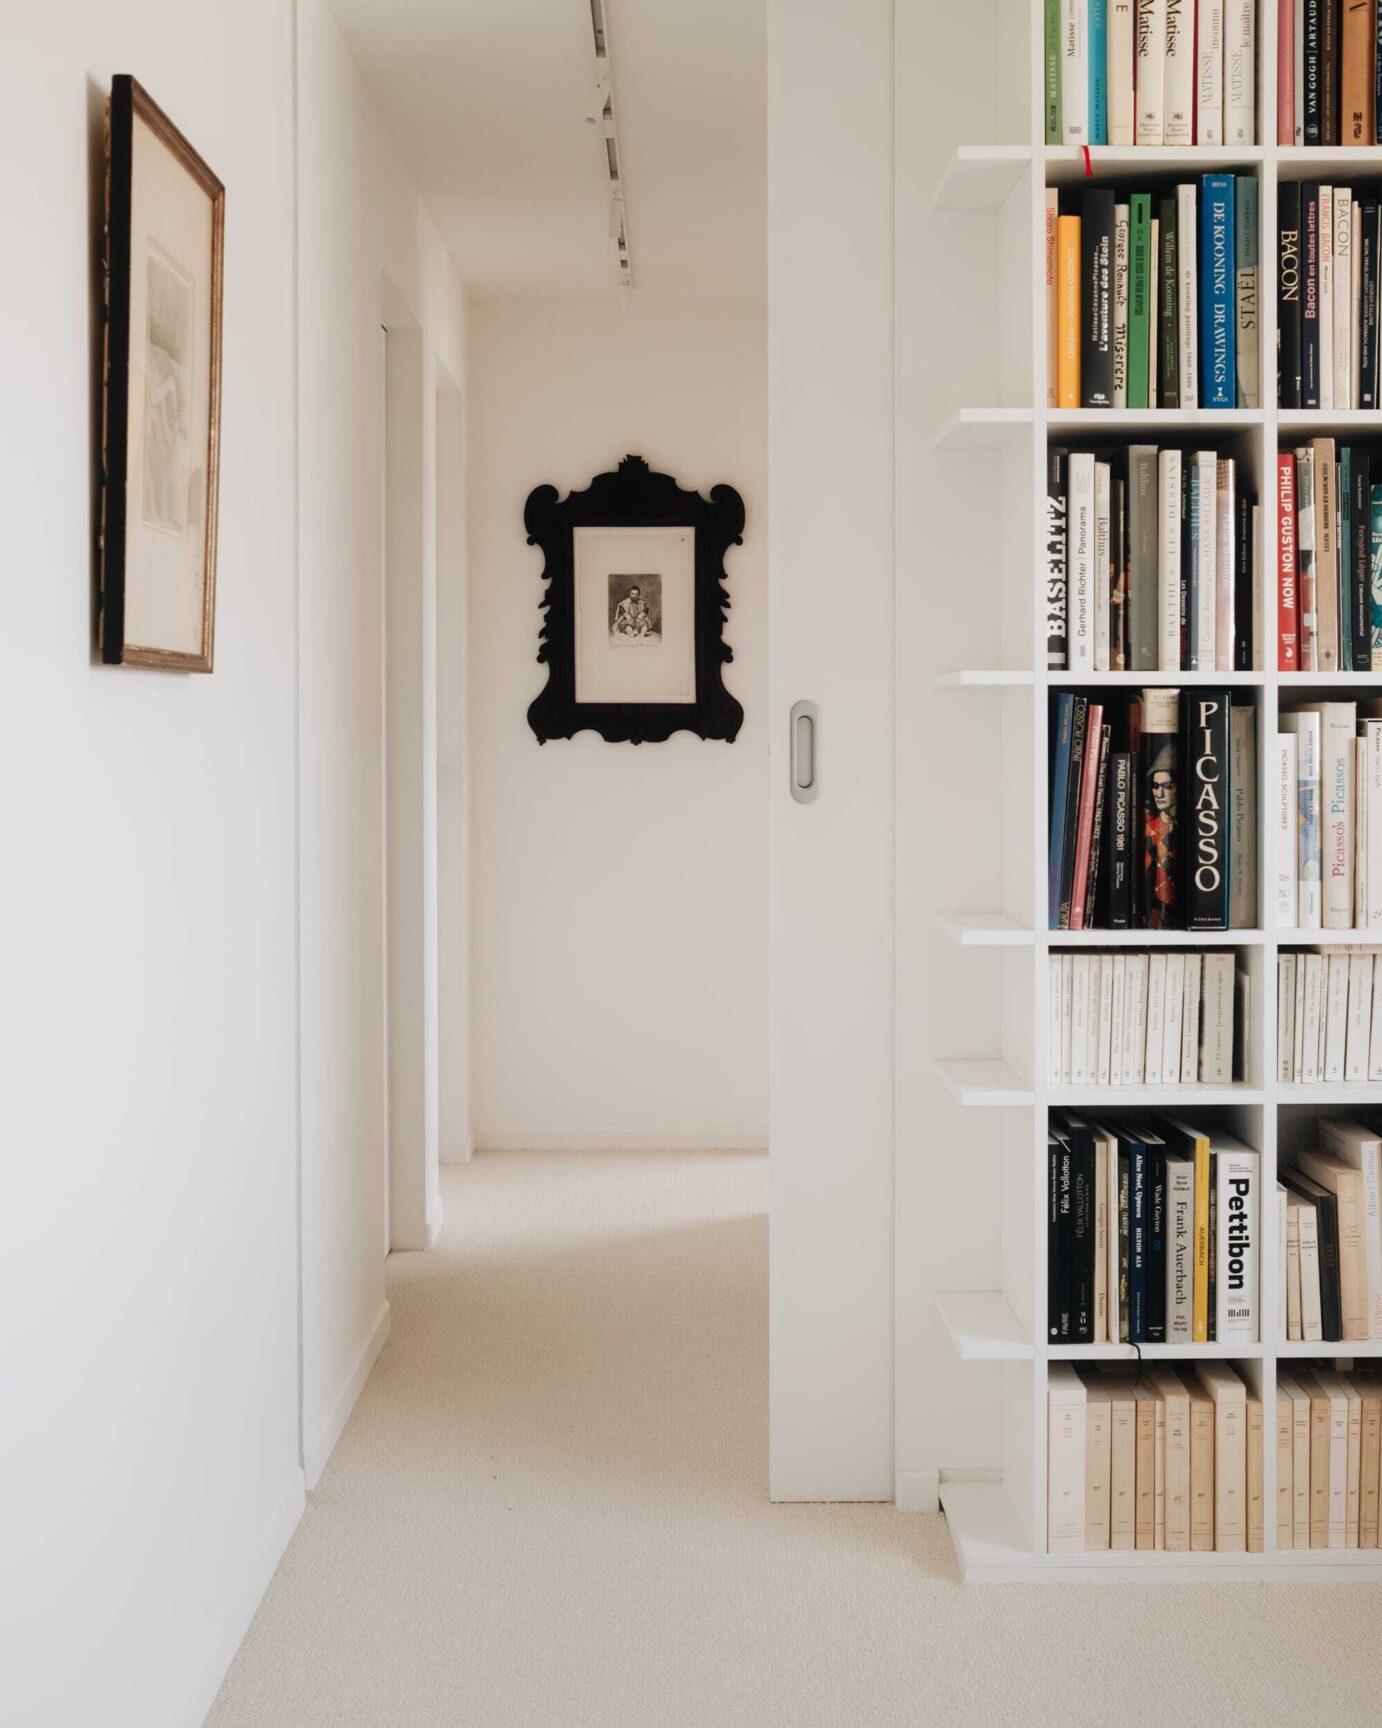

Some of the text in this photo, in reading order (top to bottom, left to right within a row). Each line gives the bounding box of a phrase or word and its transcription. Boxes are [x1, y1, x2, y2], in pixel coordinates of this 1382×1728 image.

[1067, 21, 1075, 57] Matisse
[1139, 0, 1155, 57] Matisse
[1166, 0, 1182, 57] Matisse
[1201, 8, 1220, 105] MATISSE inconnu
[1308, 0, 1316, 113] VAN GOGH ARTAUD
[1049, 54, 1057, 98] MATISSE
[1231, 50, 1243, 102] MATISSE
[1240, 39, 1251, 48] le
[1321, 193, 1330, 229] FRANCIS
[1337, 198, 1349, 257] BACON
[1046, 207, 1055, 286] Shozo Shimamoto
[1163, 231, 1175, 317] Willem de Kooning
[1281, 229, 1299, 302] BACON
[1305, 201, 1316, 319] Bacon en toutes lettres
[1321, 232, 1330, 263] BACON
[1099, 236, 1109, 352] L'aventure des Stein
[1114, 220, 1129, 391] Georges Rouault Miserere
[1213, 202, 1226, 383] DE KOONING DRAWINGS
[1237, 266, 1256, 329] STAËL
[1139, 462, 1150, 496] Balthus
[1167, 455, 1176, 520] DESSINS
[1077, 506, 1087, 554] Panorama
[1098, 517, 1109, 557] Balthus
[1191, 479, 1200, 540] BALTHUS
[1280, 466, 1294, 609] PHILIP GUSTON NOW
[1046, 495, 1066, 639] BASELITZ
[1167, 527, 1176, 554] LES
[1203, 528, 1212, 558] HANS
[1358, 525, 1366, 558] Fernand
[1077, 562, 1087, 595] Richter
[1180, 579, 1188, 590] Les
[1357, 559, 1366, 582] Léger
[1077, 598, 1087, 637] Gerhard
[1180, 617, 1188, 626] de
[1072, 704, 1084, 762] PABLO PICASSO
[1116, 759, 1126, 851] PABLO PICASSO 1981
[1195, 701, 1221, 893] PICASSO
[1235, 788, 1245, 842] Pablo Picasso
[1331, 757, 1345, 878] Picasso's Picassos
[1060, 1155, 1070, 1214] Félix Vallotton
[1075, 1173, 1084, 1238] FÉLIX VALLOTTON
[1134, 1191, 1143, 1218] Uptown
[1135, 1173, 1143, 1191] Neel,
[1152, 1184, 1162, 1233] Wade Guyton
[1366, 1150, 1377, 1217] Albert Camus
[1097, 1203, 1105, 1228] Georges
[1175, 1201, 1187, 1239] Frank
[1228, 1178, 1251, 1290] Pettibon
[1175, 1242, 1187, 1305] Auerbach
[1061, 1312, 1069, 1335] FAVRE
